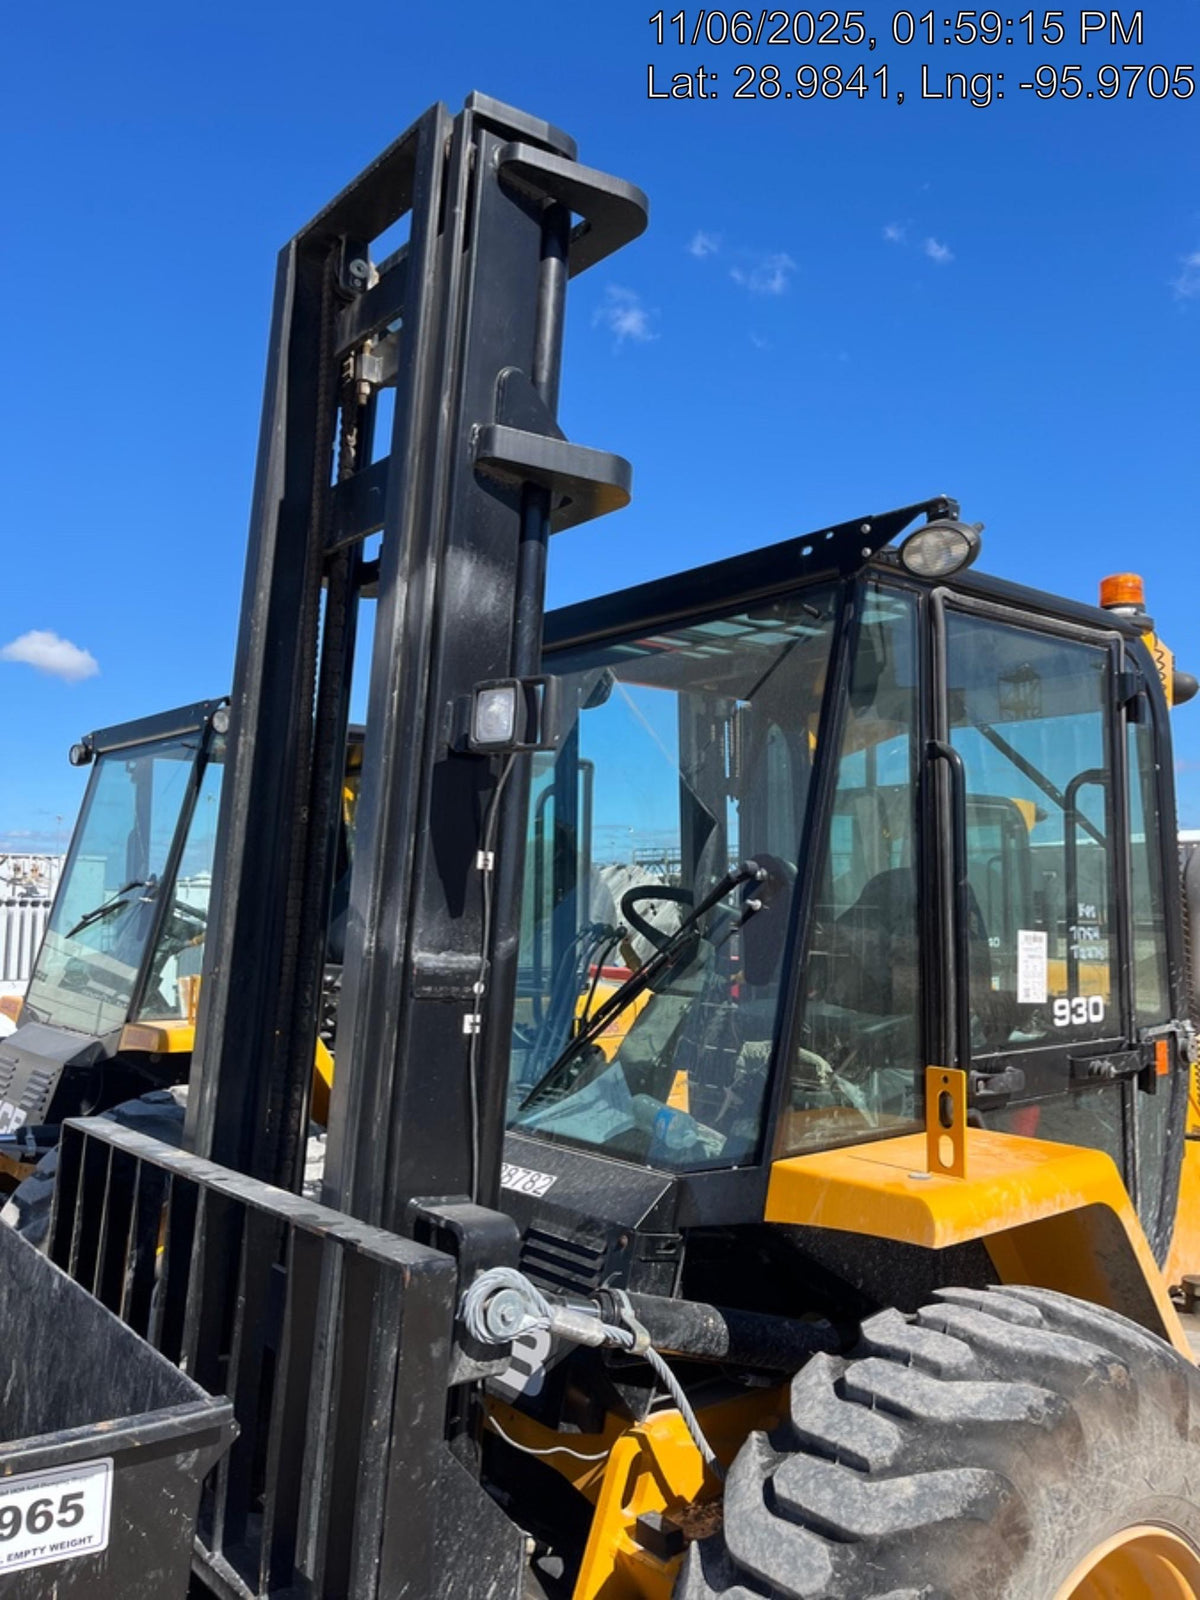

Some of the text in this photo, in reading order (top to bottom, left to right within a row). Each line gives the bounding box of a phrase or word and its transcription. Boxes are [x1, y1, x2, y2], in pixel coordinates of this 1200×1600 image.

[1053, 995, 1105, 1027] 930
[0, 1491, 85, 1542] 965
[7, 1535, 94, 1562] EMPTY WEIGHT
